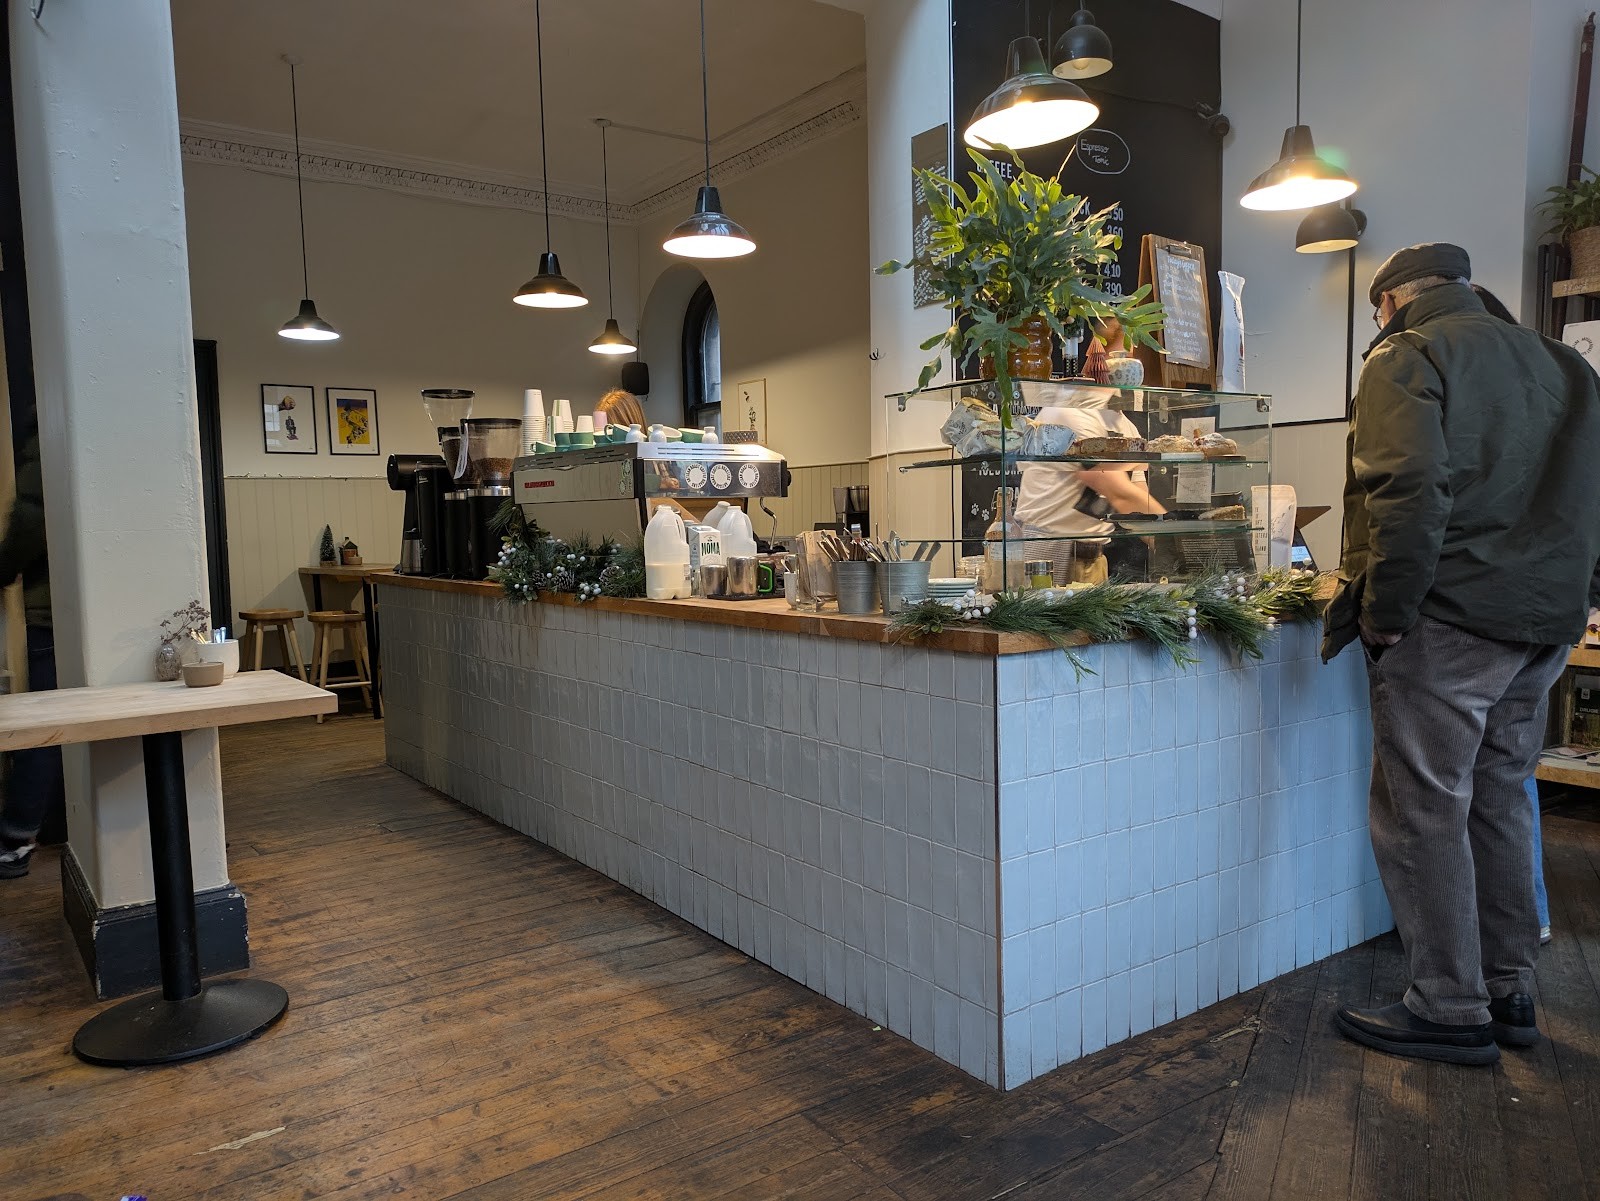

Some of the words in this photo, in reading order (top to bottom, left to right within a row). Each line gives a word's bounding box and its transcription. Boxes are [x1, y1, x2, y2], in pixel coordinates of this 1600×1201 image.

[1081, 139, 1109, 155] Espresso
[1092, 155, 1109, 165] Tonic
[701, 542, 721, 556] MOMA
